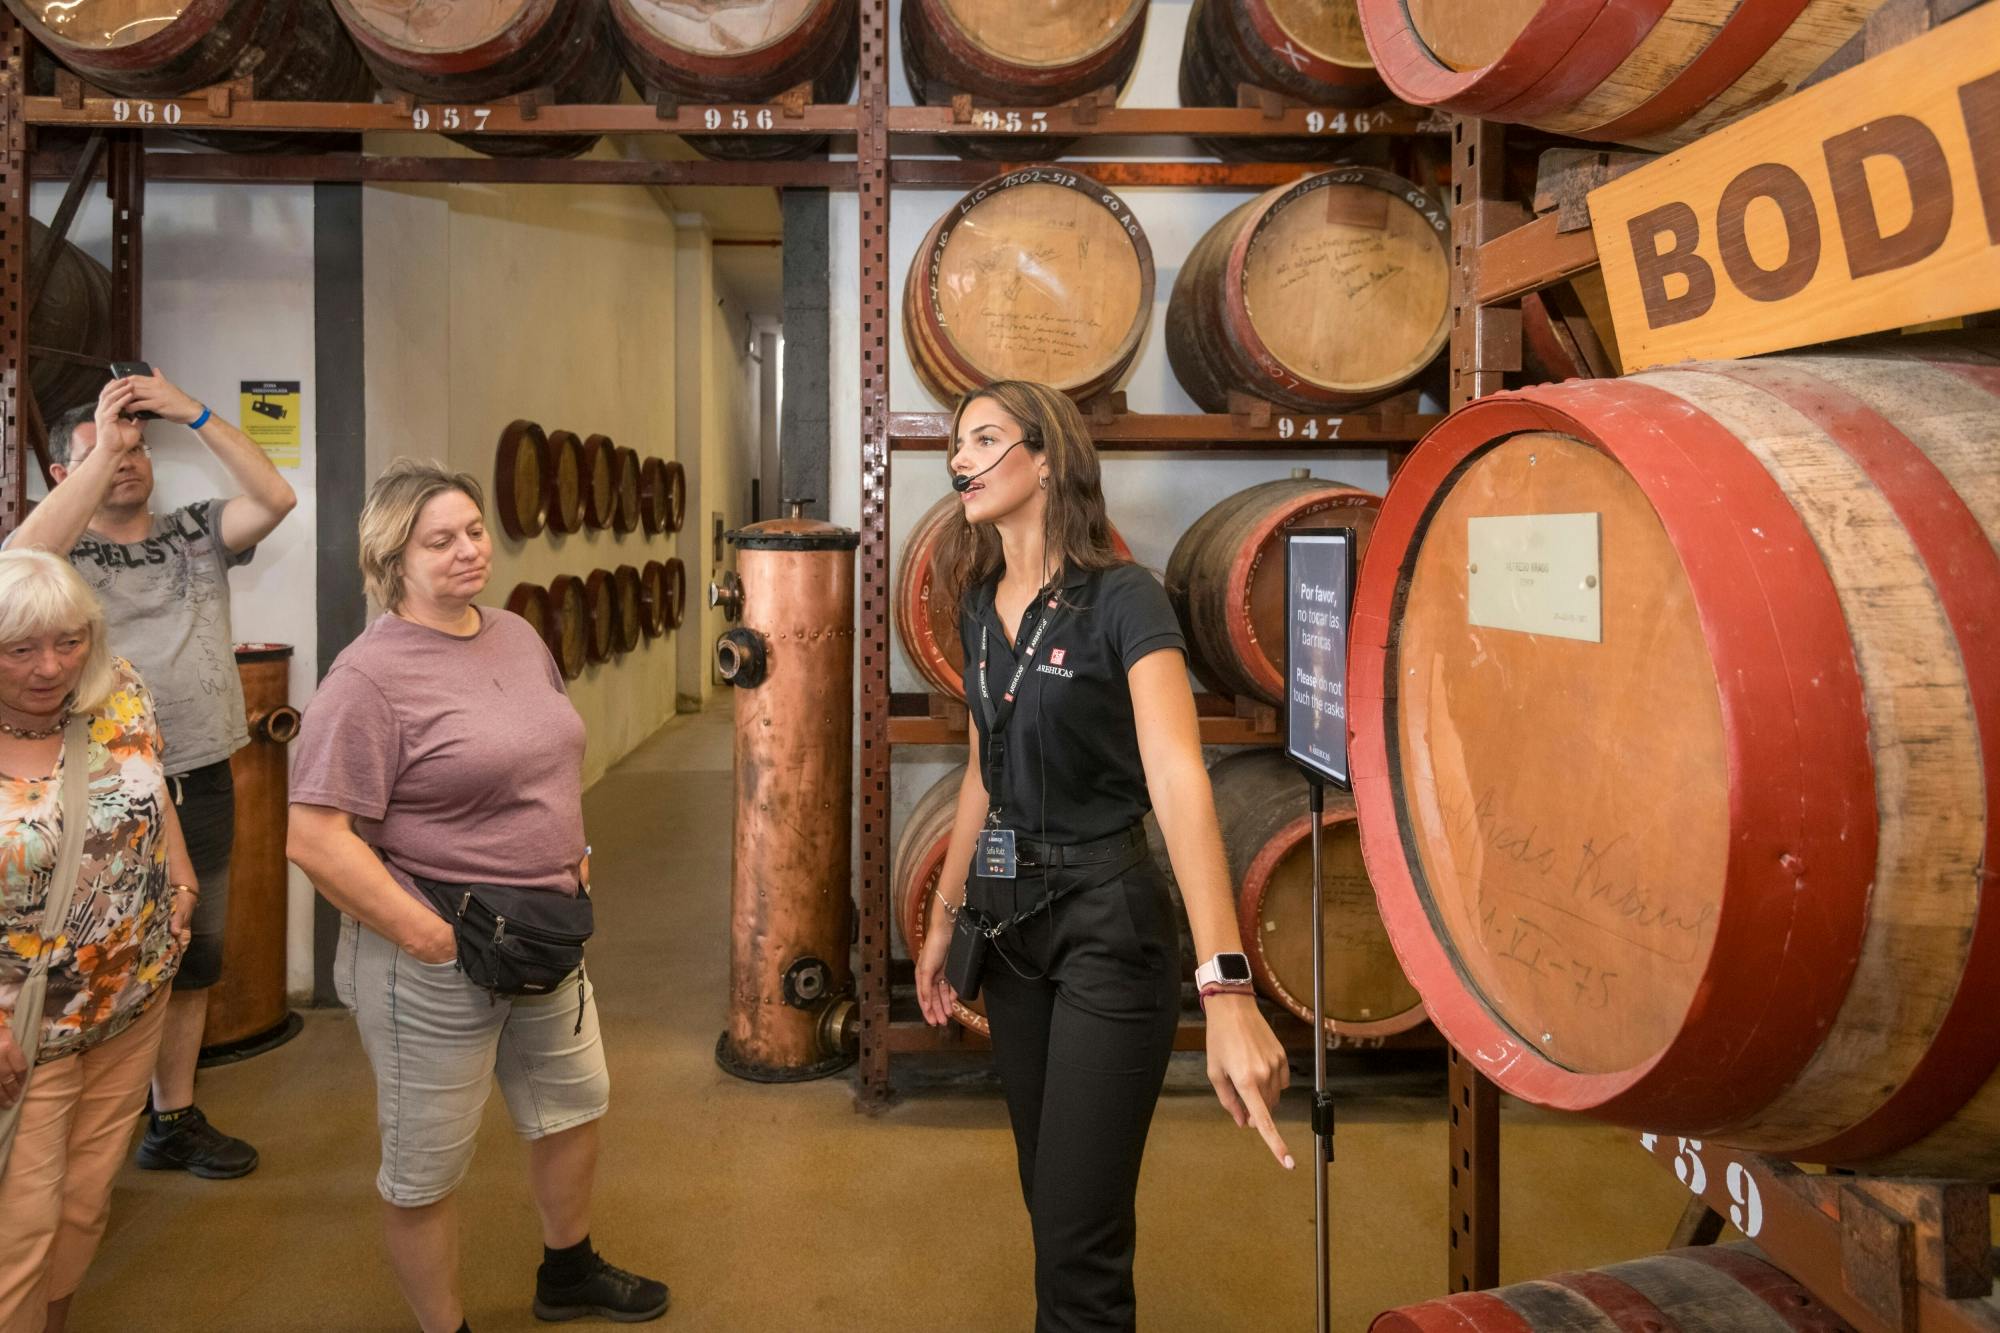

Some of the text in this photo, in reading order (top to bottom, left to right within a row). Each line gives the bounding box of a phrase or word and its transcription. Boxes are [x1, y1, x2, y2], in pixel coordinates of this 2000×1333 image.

[112, 99, 181, 125] 960
[412, 108, 491, 131] 957
[704, 108, 773, 130] 956
[1305, 111, 1372, 134] 946
[1627, 68, 2000, 330] BOD
[1278, 417, 1344, 439] 947
[1301, 583, 1337, 608] Por favor,
[1297, 609, 1340, 629] no tocar las
[1302, 628, 1331, 651] barricas
[1036, 664, 1074, 678] AREHUCAS
[1296, 667, 1342, 697] Please do not
[1293, 688, 1345, 719] touch the casks
[1640, 1131, 1763, 1238] 59
